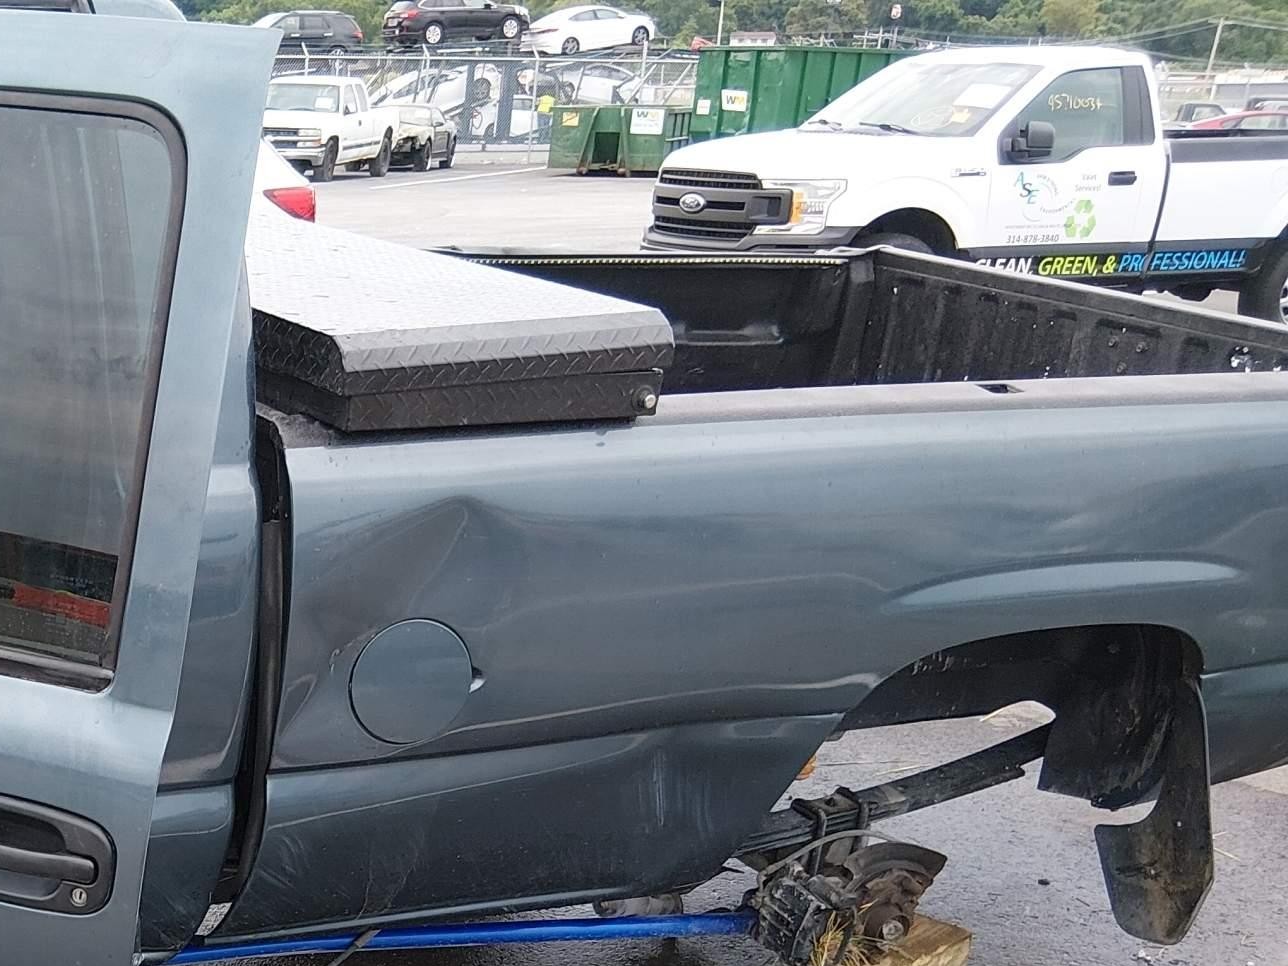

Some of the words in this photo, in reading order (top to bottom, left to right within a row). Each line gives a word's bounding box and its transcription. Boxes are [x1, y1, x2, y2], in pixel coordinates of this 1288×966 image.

[1005, 234, 1060, 244] 314-878-3840
[1038, 256, 1098, 276] GREEN,
[1102, 255, 1116, 273] &
